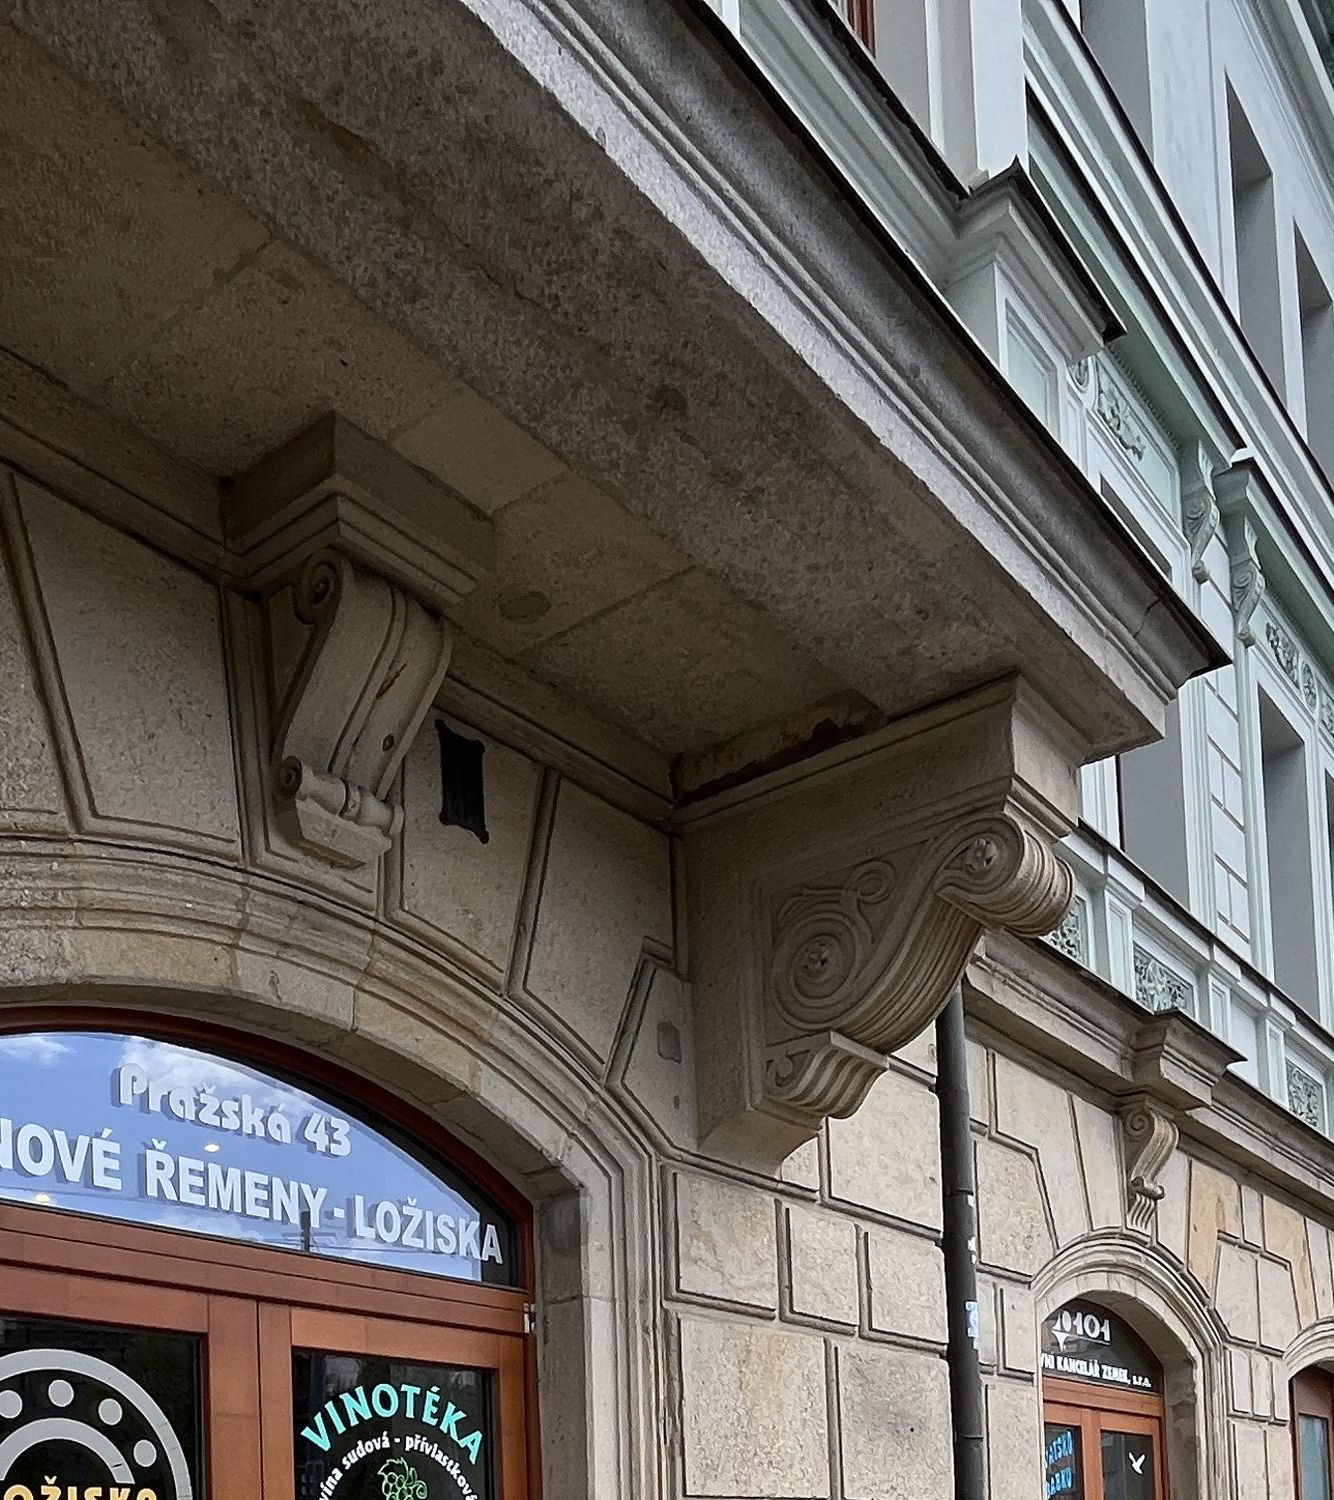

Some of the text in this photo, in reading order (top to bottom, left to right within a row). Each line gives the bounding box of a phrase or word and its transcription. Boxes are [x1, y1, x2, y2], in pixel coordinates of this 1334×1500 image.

[118, 1063, 352, 1157] Pražská 43
[300, 1383, 483, 1465] VINOTÉKA
[342, 1431, 390, 1470] sudová
